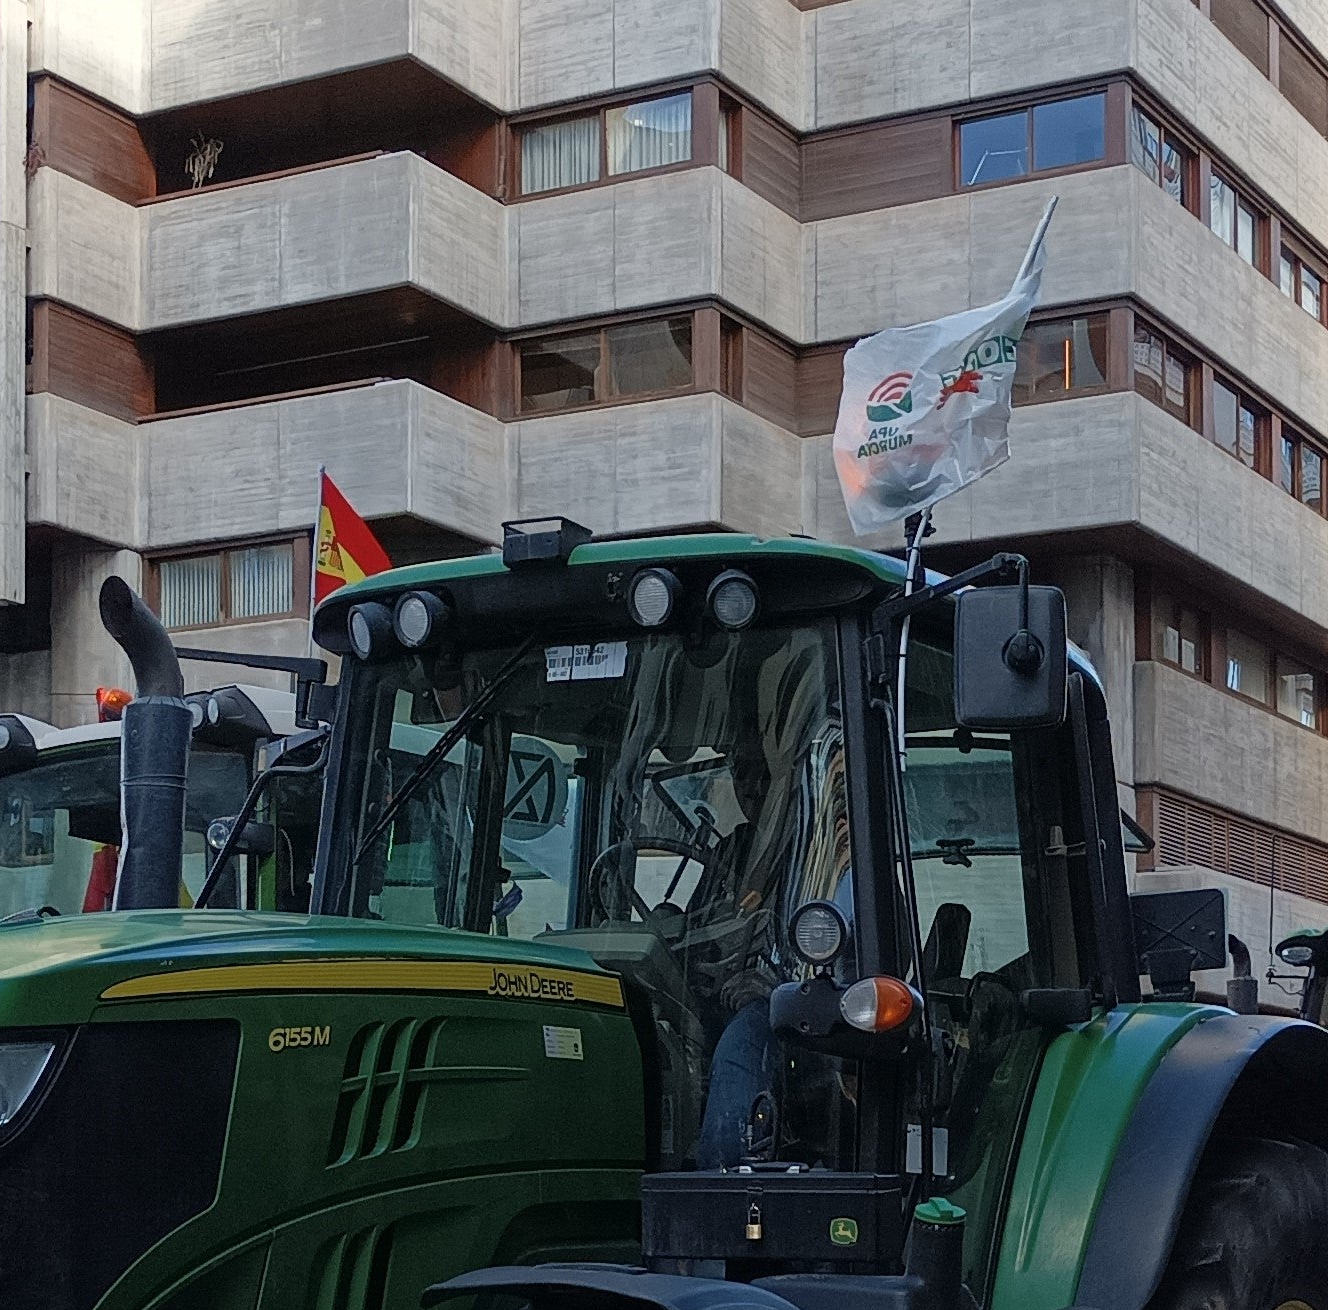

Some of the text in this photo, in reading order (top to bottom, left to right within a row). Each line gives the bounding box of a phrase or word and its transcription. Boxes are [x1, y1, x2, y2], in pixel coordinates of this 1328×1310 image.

[489, 967, 575, 998] JOHN DEERE
[268, 1025, 331, 1052] 6155 M
